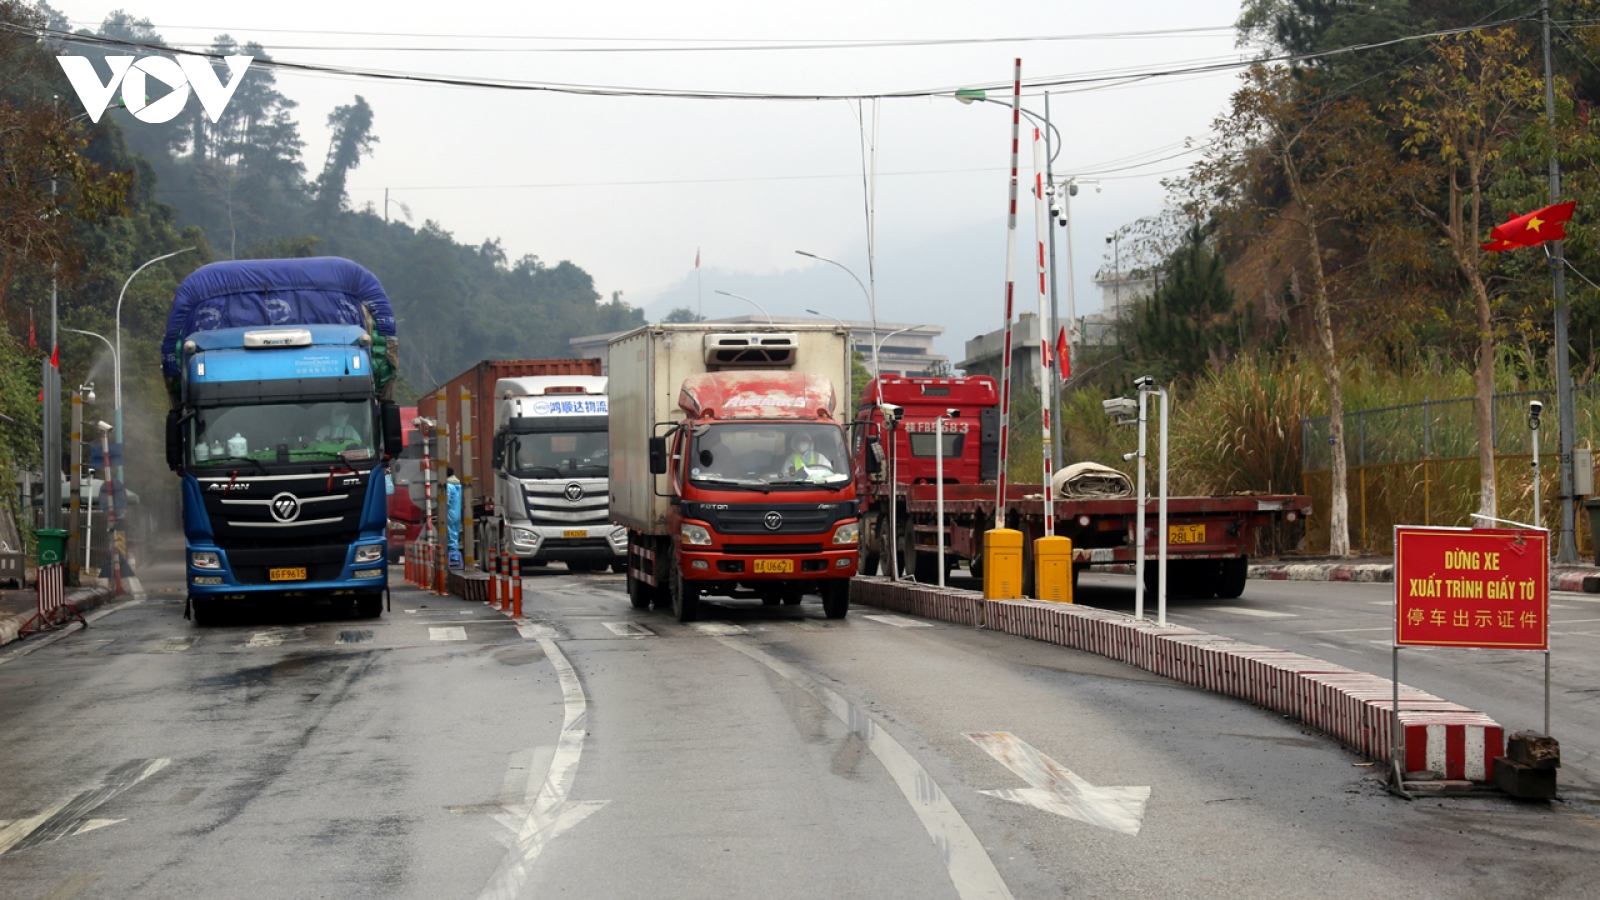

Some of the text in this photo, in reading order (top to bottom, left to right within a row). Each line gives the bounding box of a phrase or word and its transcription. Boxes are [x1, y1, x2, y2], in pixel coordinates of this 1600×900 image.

[550, 400, 609, 414] 鸿顺达物流
[1445, 547, 1500, 570] DỪNG XE
[1409, 572, 1535, 600] XUẤT TRÌNH GIẤY TỜ
[1407, 607, 1537, 629] 停车出示证件
